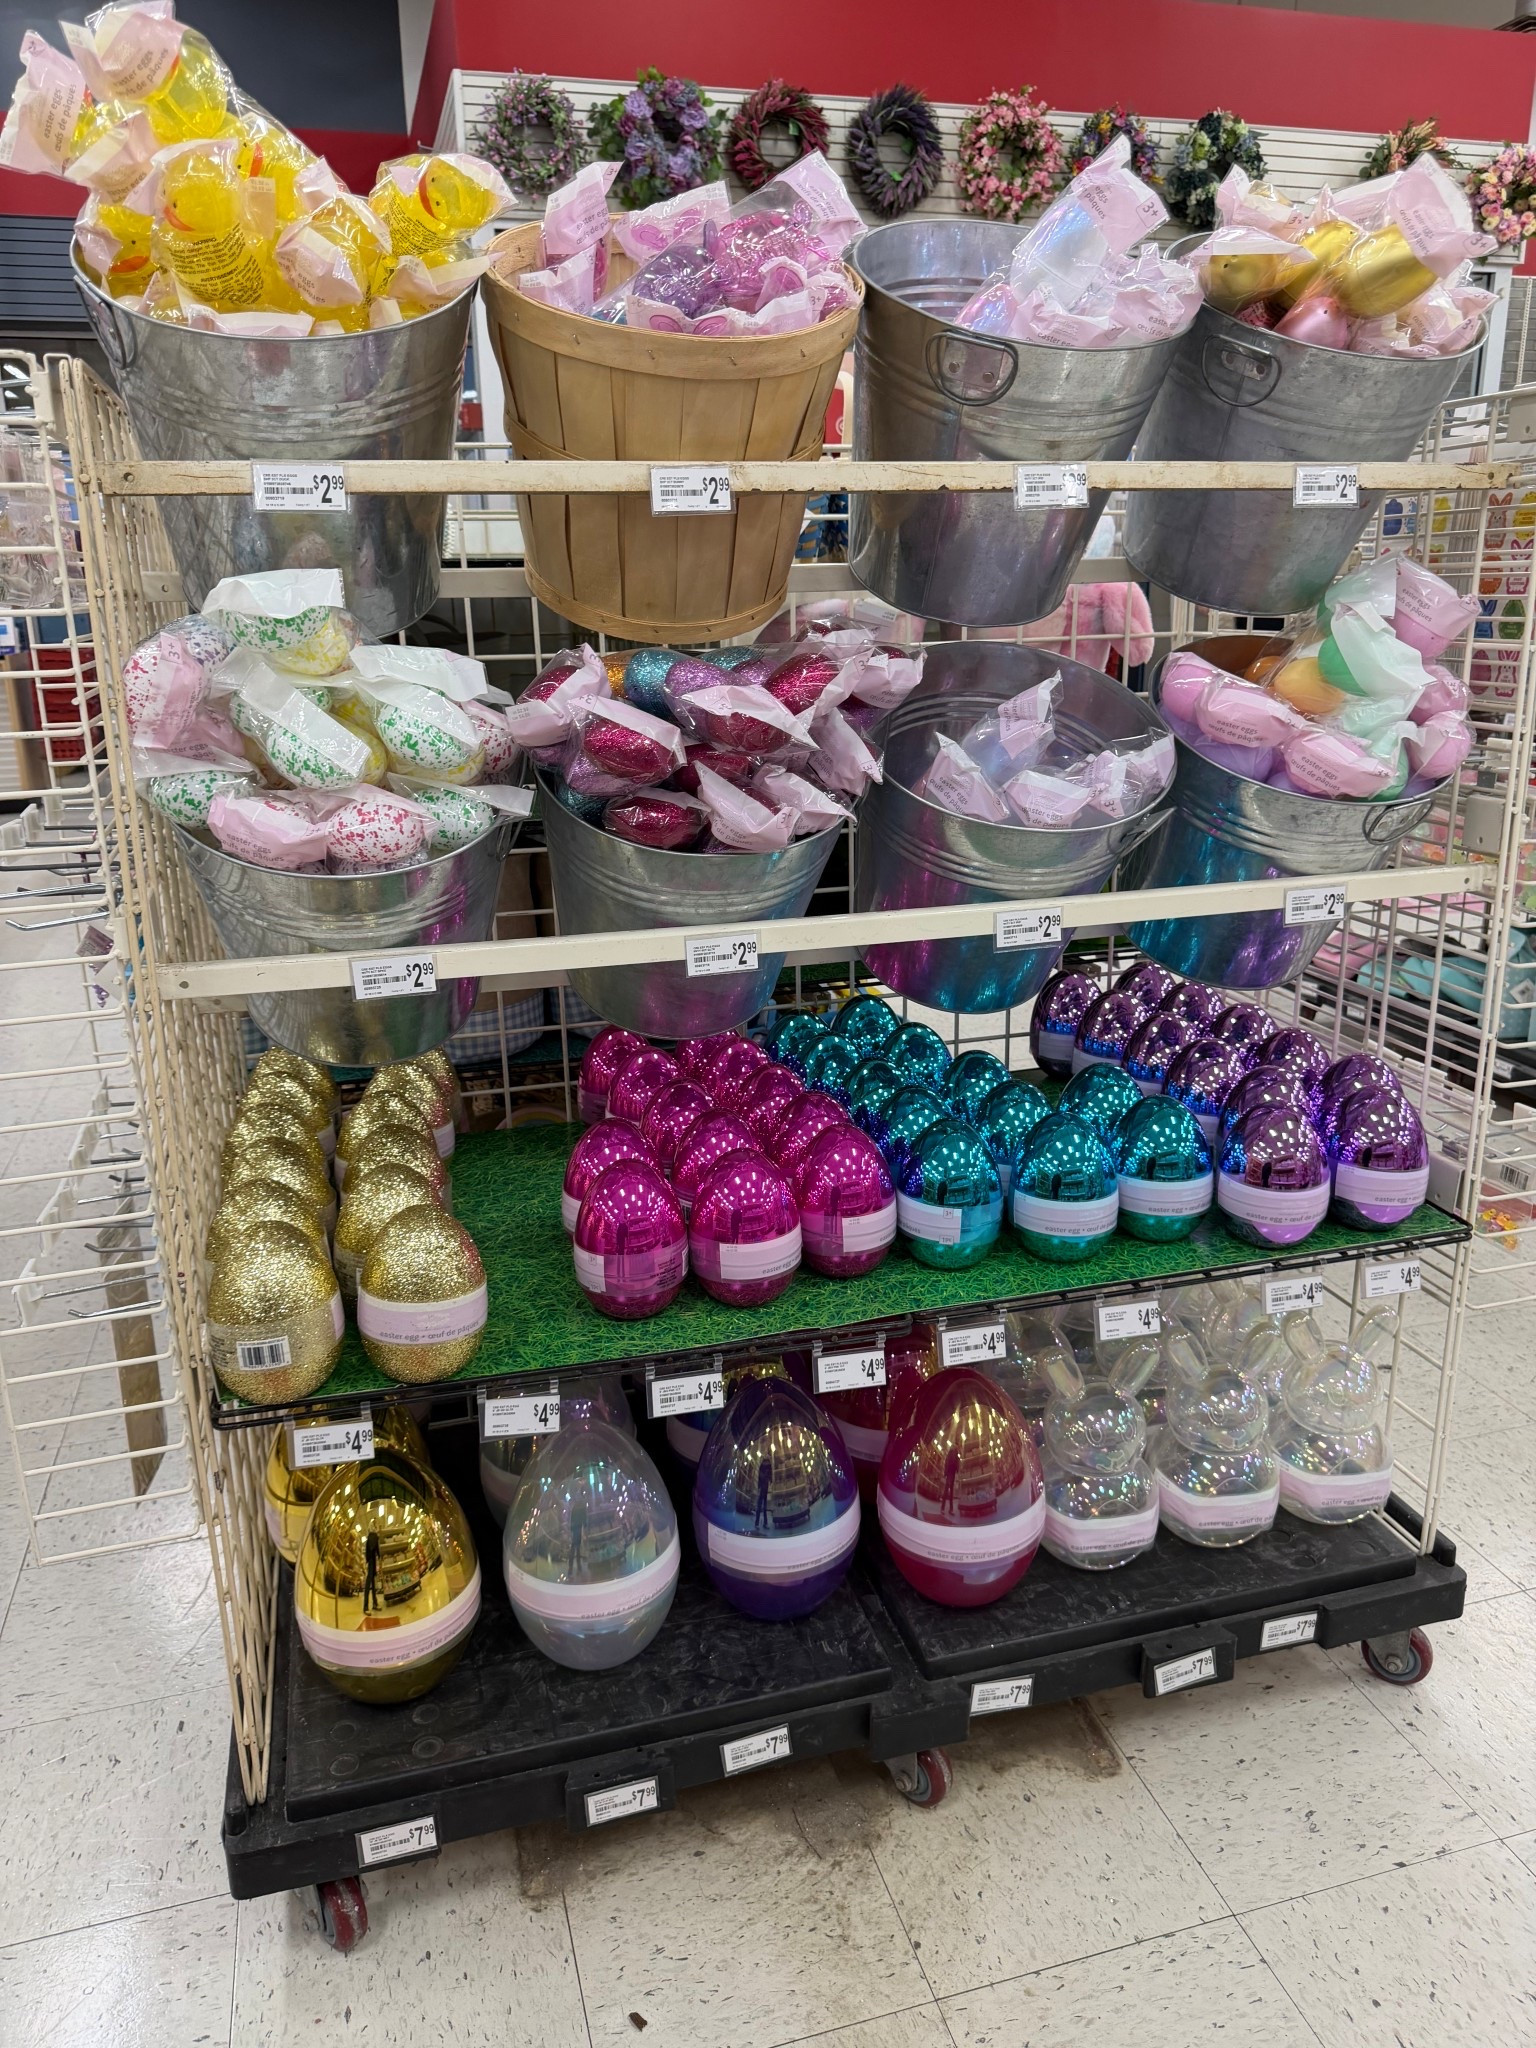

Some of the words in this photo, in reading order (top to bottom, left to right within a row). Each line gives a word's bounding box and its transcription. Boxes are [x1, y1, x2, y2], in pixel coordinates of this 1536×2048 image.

[136, 50, 153, 71] eggs
[44, 110, 55, 139] easter
[51, 88, 62, 110] eggs
[60, 119, 68, 130] de
[64, 84, 77, 117] pâques
[1095, 186, 1109, 204] eggs
[1085, 192, 1106, 219] pâques
[1142, 201, 1158, 218] 3+
[811, 296, 822, 306] 3+
[1417, 597, 1431, 610] eggs
[1410, 606, 1432, 622] pâques
[168, 642, 180, 660] 3+
[1216, 719, 1239, 731] easter
[1241, 726, 1258, 735] eggs
[1227, 730, 1237, 738] de
[1290, 758, 1306, 774] œufs
[1305, 770, 1316, 780] de
[1315, 775, 1341, 792] pâques
[1301, 755, 1322, 771] easter
[1322, 768, 1338, 781] eggs
[939, 776, 958, 793] easter
[956, 789, 969, 806] eggs
[943, 791, 951, 799] de
[1104, 800, 1117, 813] 3+
[781, 812, 793, 824] 3+
[1032, 817, 1042, 825] de
[1046, 813, 1063, 822] eggs
[226, 833, 252, 846] easter
[253, 842, 272, 854] eggs
[1171, 1206, 1184, 1214] egg
[1045, 1226, 1067, 1234] easter
[1068, 1227, 1081, 1235] egg
[762, 1265, 782, 1275] easter
[781, 1259, 792, 1269] egg
[380, 1331, 402, 1340] easter
[428, 1331, 445, 1339] œuf
[446, 1328, 456, 1336] de
[369, 1656, 394, 1664] easter
[397, 1653, 411, 1661] egg
